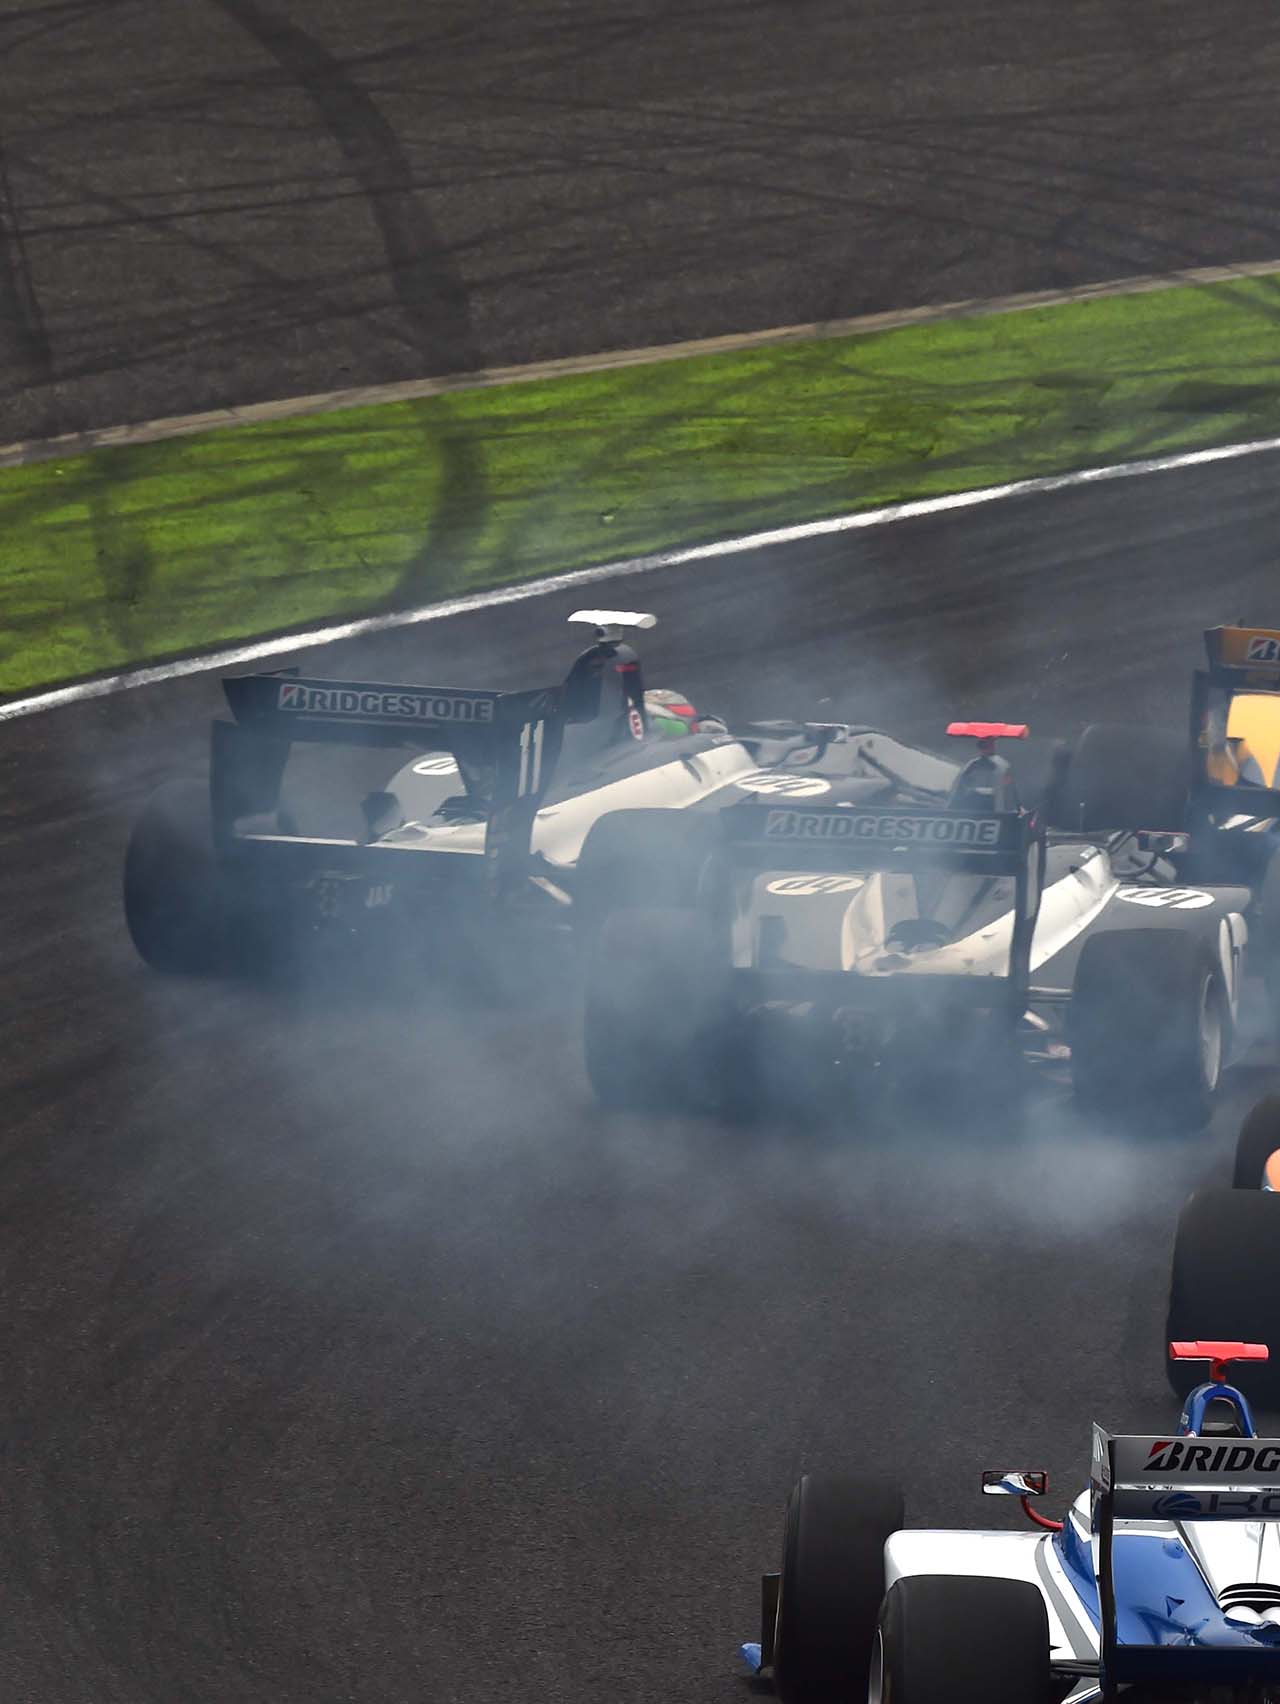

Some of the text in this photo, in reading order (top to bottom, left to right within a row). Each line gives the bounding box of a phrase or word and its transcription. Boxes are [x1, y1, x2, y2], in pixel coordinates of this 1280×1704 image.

[283, 686, 492, 720] BRIDGESTONE
[517, 719, 545, 798] 11
[768, 812, 997, 843] BRIDGESTONE
